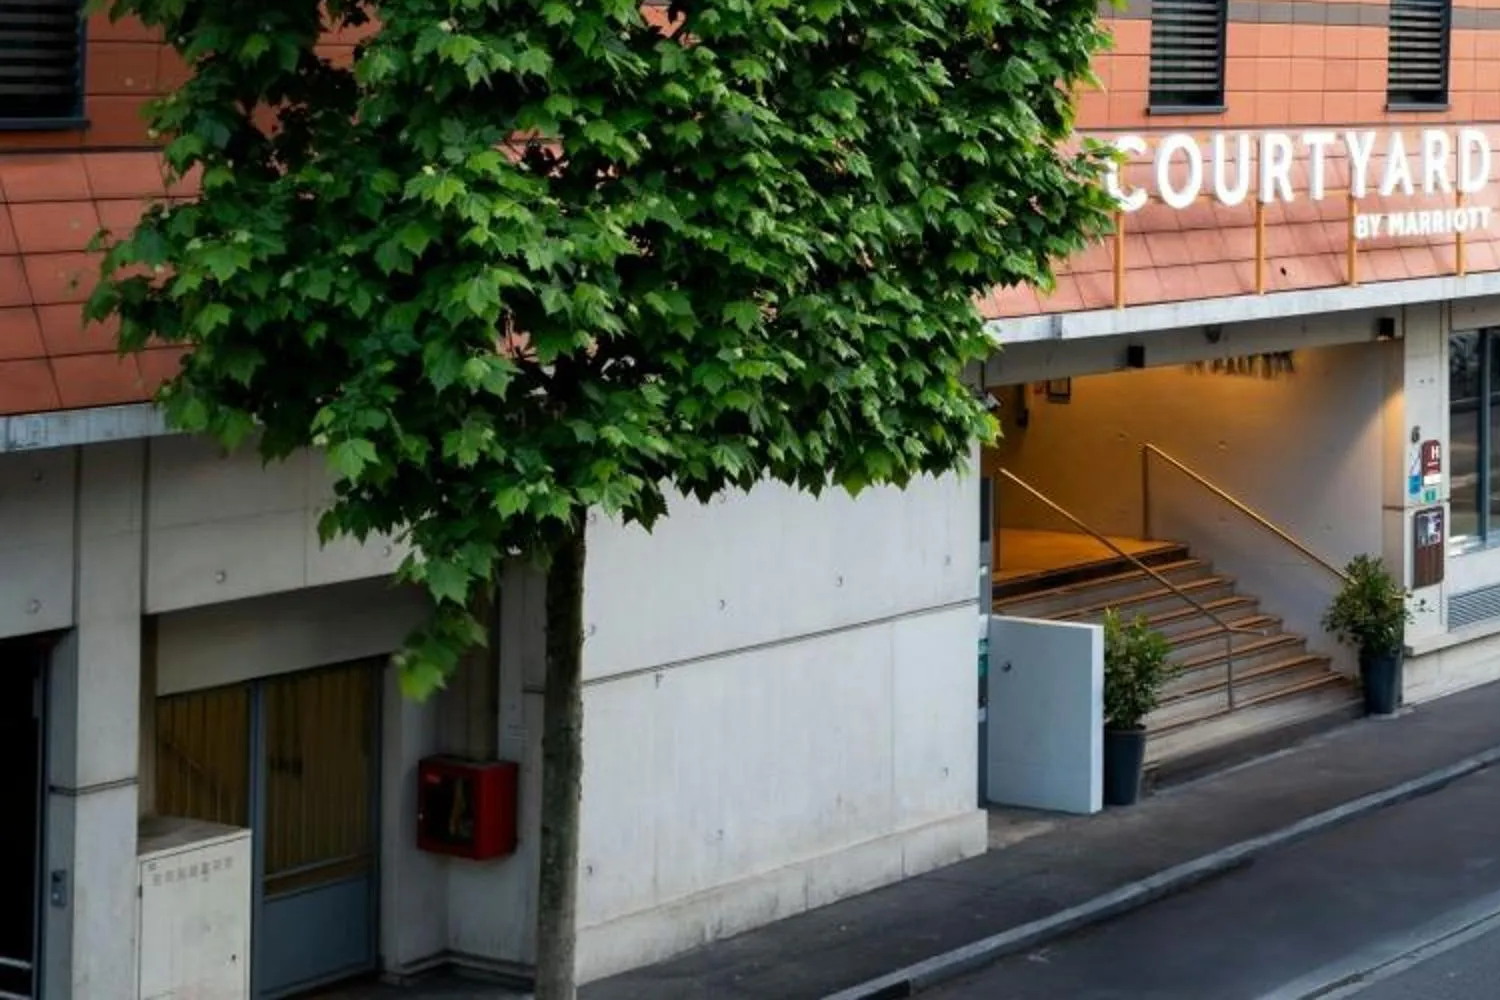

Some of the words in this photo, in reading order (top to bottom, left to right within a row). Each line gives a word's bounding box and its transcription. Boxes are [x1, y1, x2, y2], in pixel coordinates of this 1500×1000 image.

[1104, 129, 1492, 212] COURTYARD
[1354, 212, 1382, 239] BY
[1387, 205, 1492, 238] MARRIOTT
